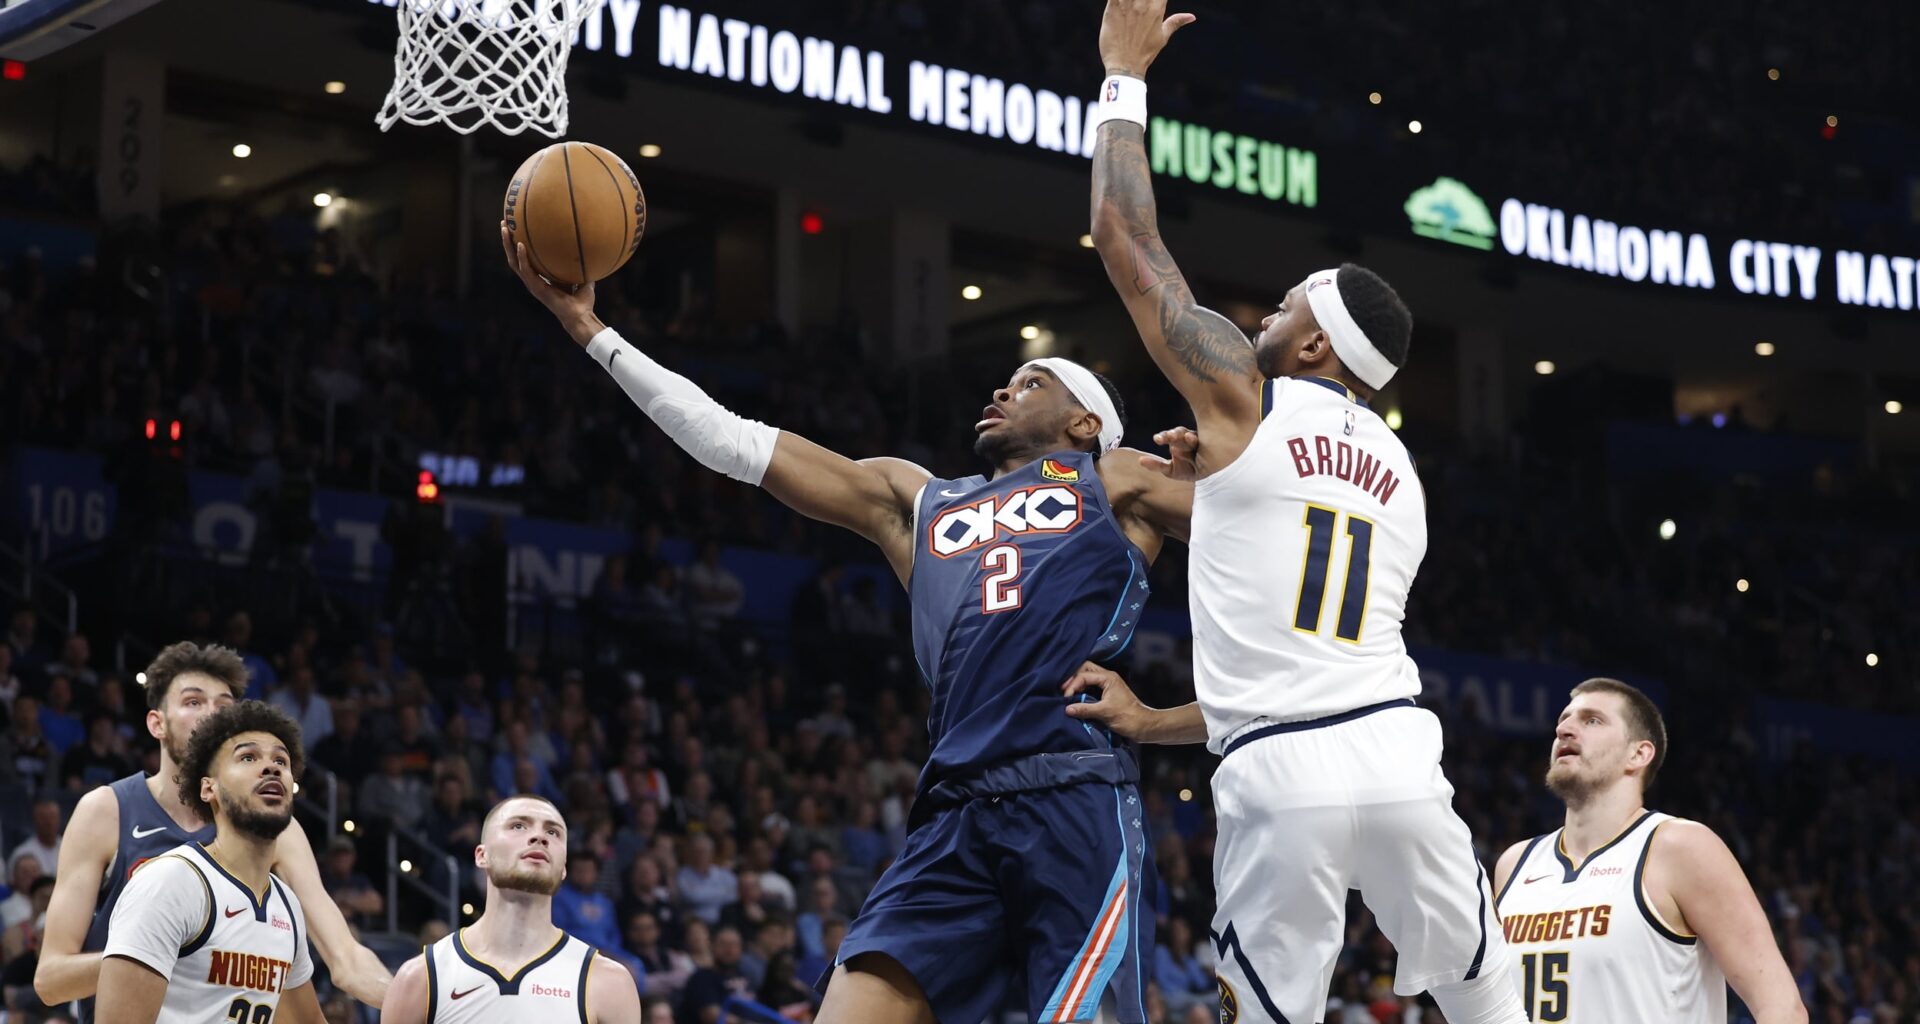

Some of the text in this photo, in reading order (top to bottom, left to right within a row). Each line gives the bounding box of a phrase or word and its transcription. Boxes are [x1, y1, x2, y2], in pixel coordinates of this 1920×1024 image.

[659, 4, 892, 113] NATIONAL
[909, 60, 1100, 160] MEMORIA
[1150, 117, 1318, 208] MUSEUM
[1501, 198, 1920, 312] OKLAHOMA CITY NAT
[1287, 435, 1400, 506] BROWN
[28, 484, 107, 542] 106
[928, 483, 1083, 560] OKC
[981, 542, 1022, 614] 2
[1292, 501, 1377, 644] 11
[1589, 865, 1623, 878] ibotta
[271, 915, 291, 931] ibotta
[1502, 903, 1612, 945] NUGGETS
[531, 983, 571, 998] ibotta
[1520, 951, 1568, 1024] 15
